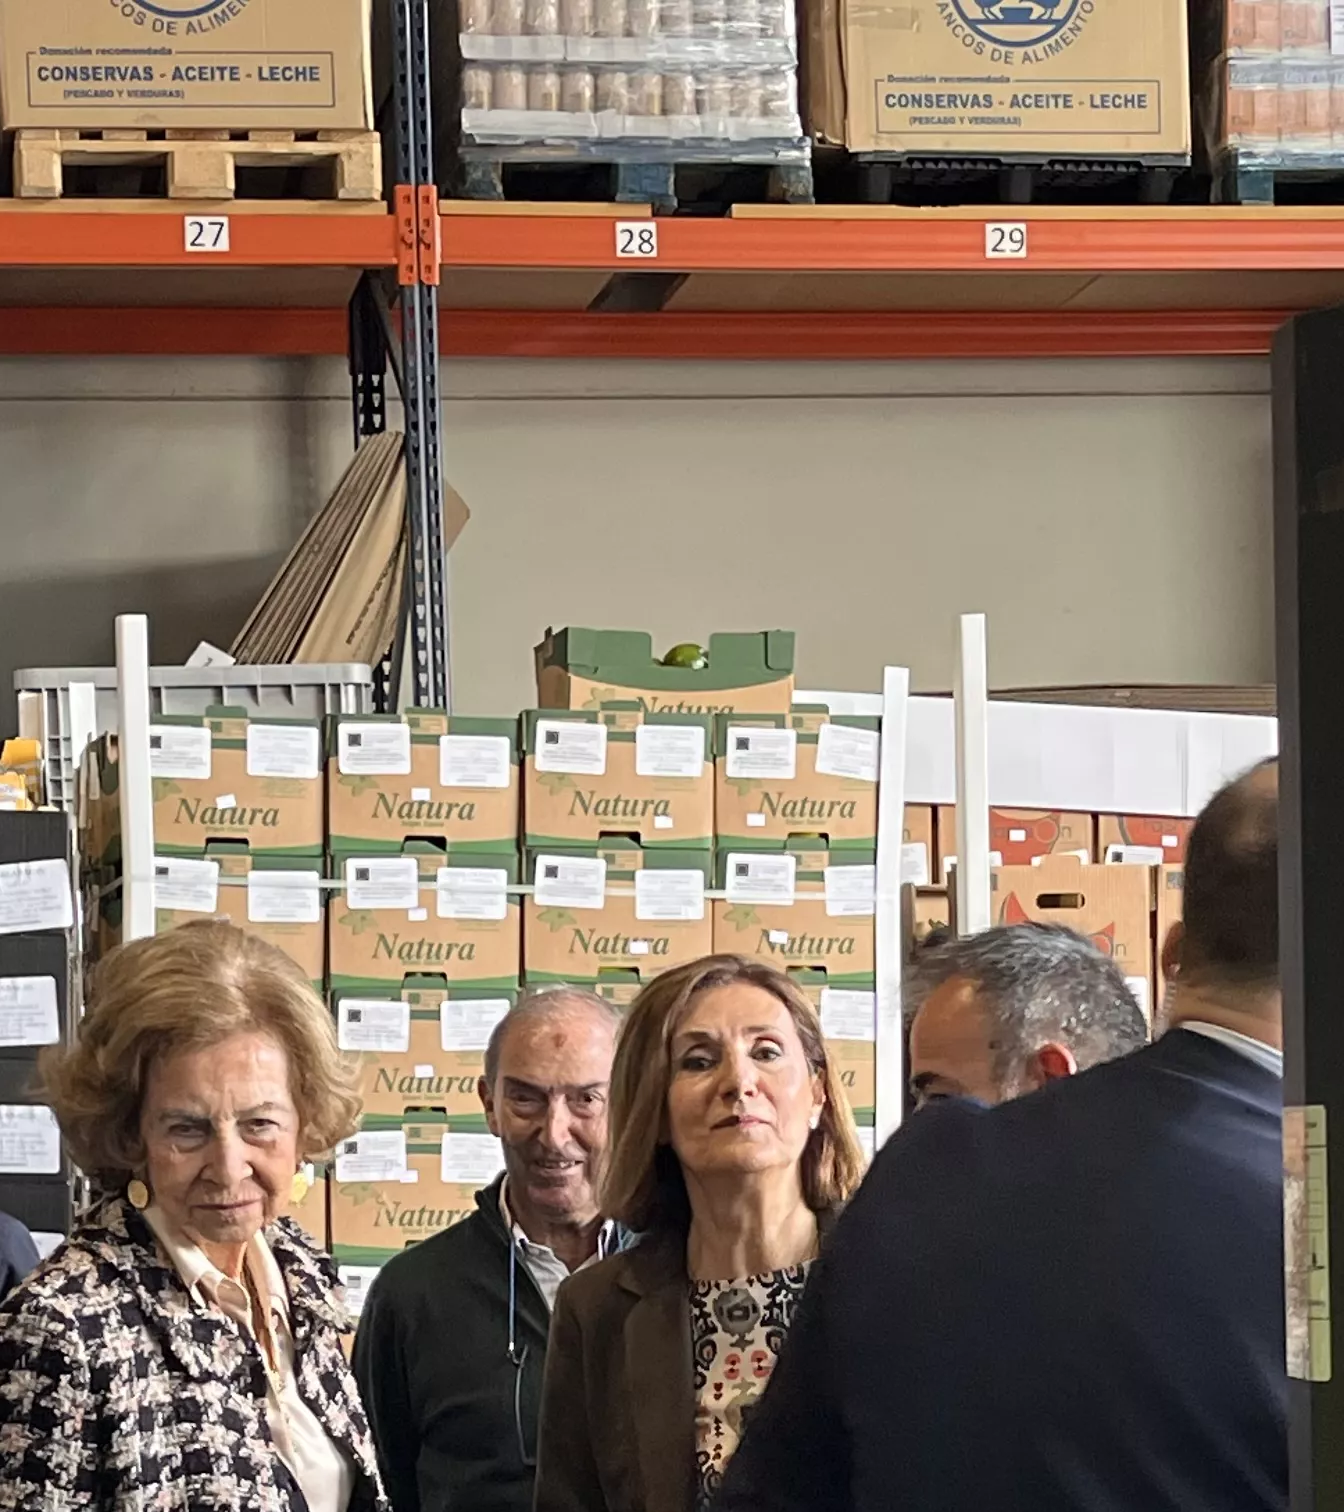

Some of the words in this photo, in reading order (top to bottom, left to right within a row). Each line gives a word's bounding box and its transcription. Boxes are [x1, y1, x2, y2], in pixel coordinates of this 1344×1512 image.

[152, 18, 178, 35] DE
[990, 48, 1015, 65] DE
[37, 66, 154, 82] CONSERVAS
[171, 66, 240, 82] ACEITE
[258, 66, 320, 82] LECHE
[885, 94, 993, 109] CONSERVAS
[1009, 93, 1074, 109] ACEITE
[1090, 93, 1148, 109] LECHE
[189, 220, 224, 248] 27
[619, 227, 655, 255] 28
[991, 226, 1024, 254] 29
[173, 798, 280, 827] Natura
[371, 792, 476, 821] Natura
[568, 790, 671, 817] Natura
[758, 791, 856, 819] Natura
[371, 933, 476, 961] Natura
[568, 928, 670, 955] Natura
[756, 928, 856, 955] Natura
